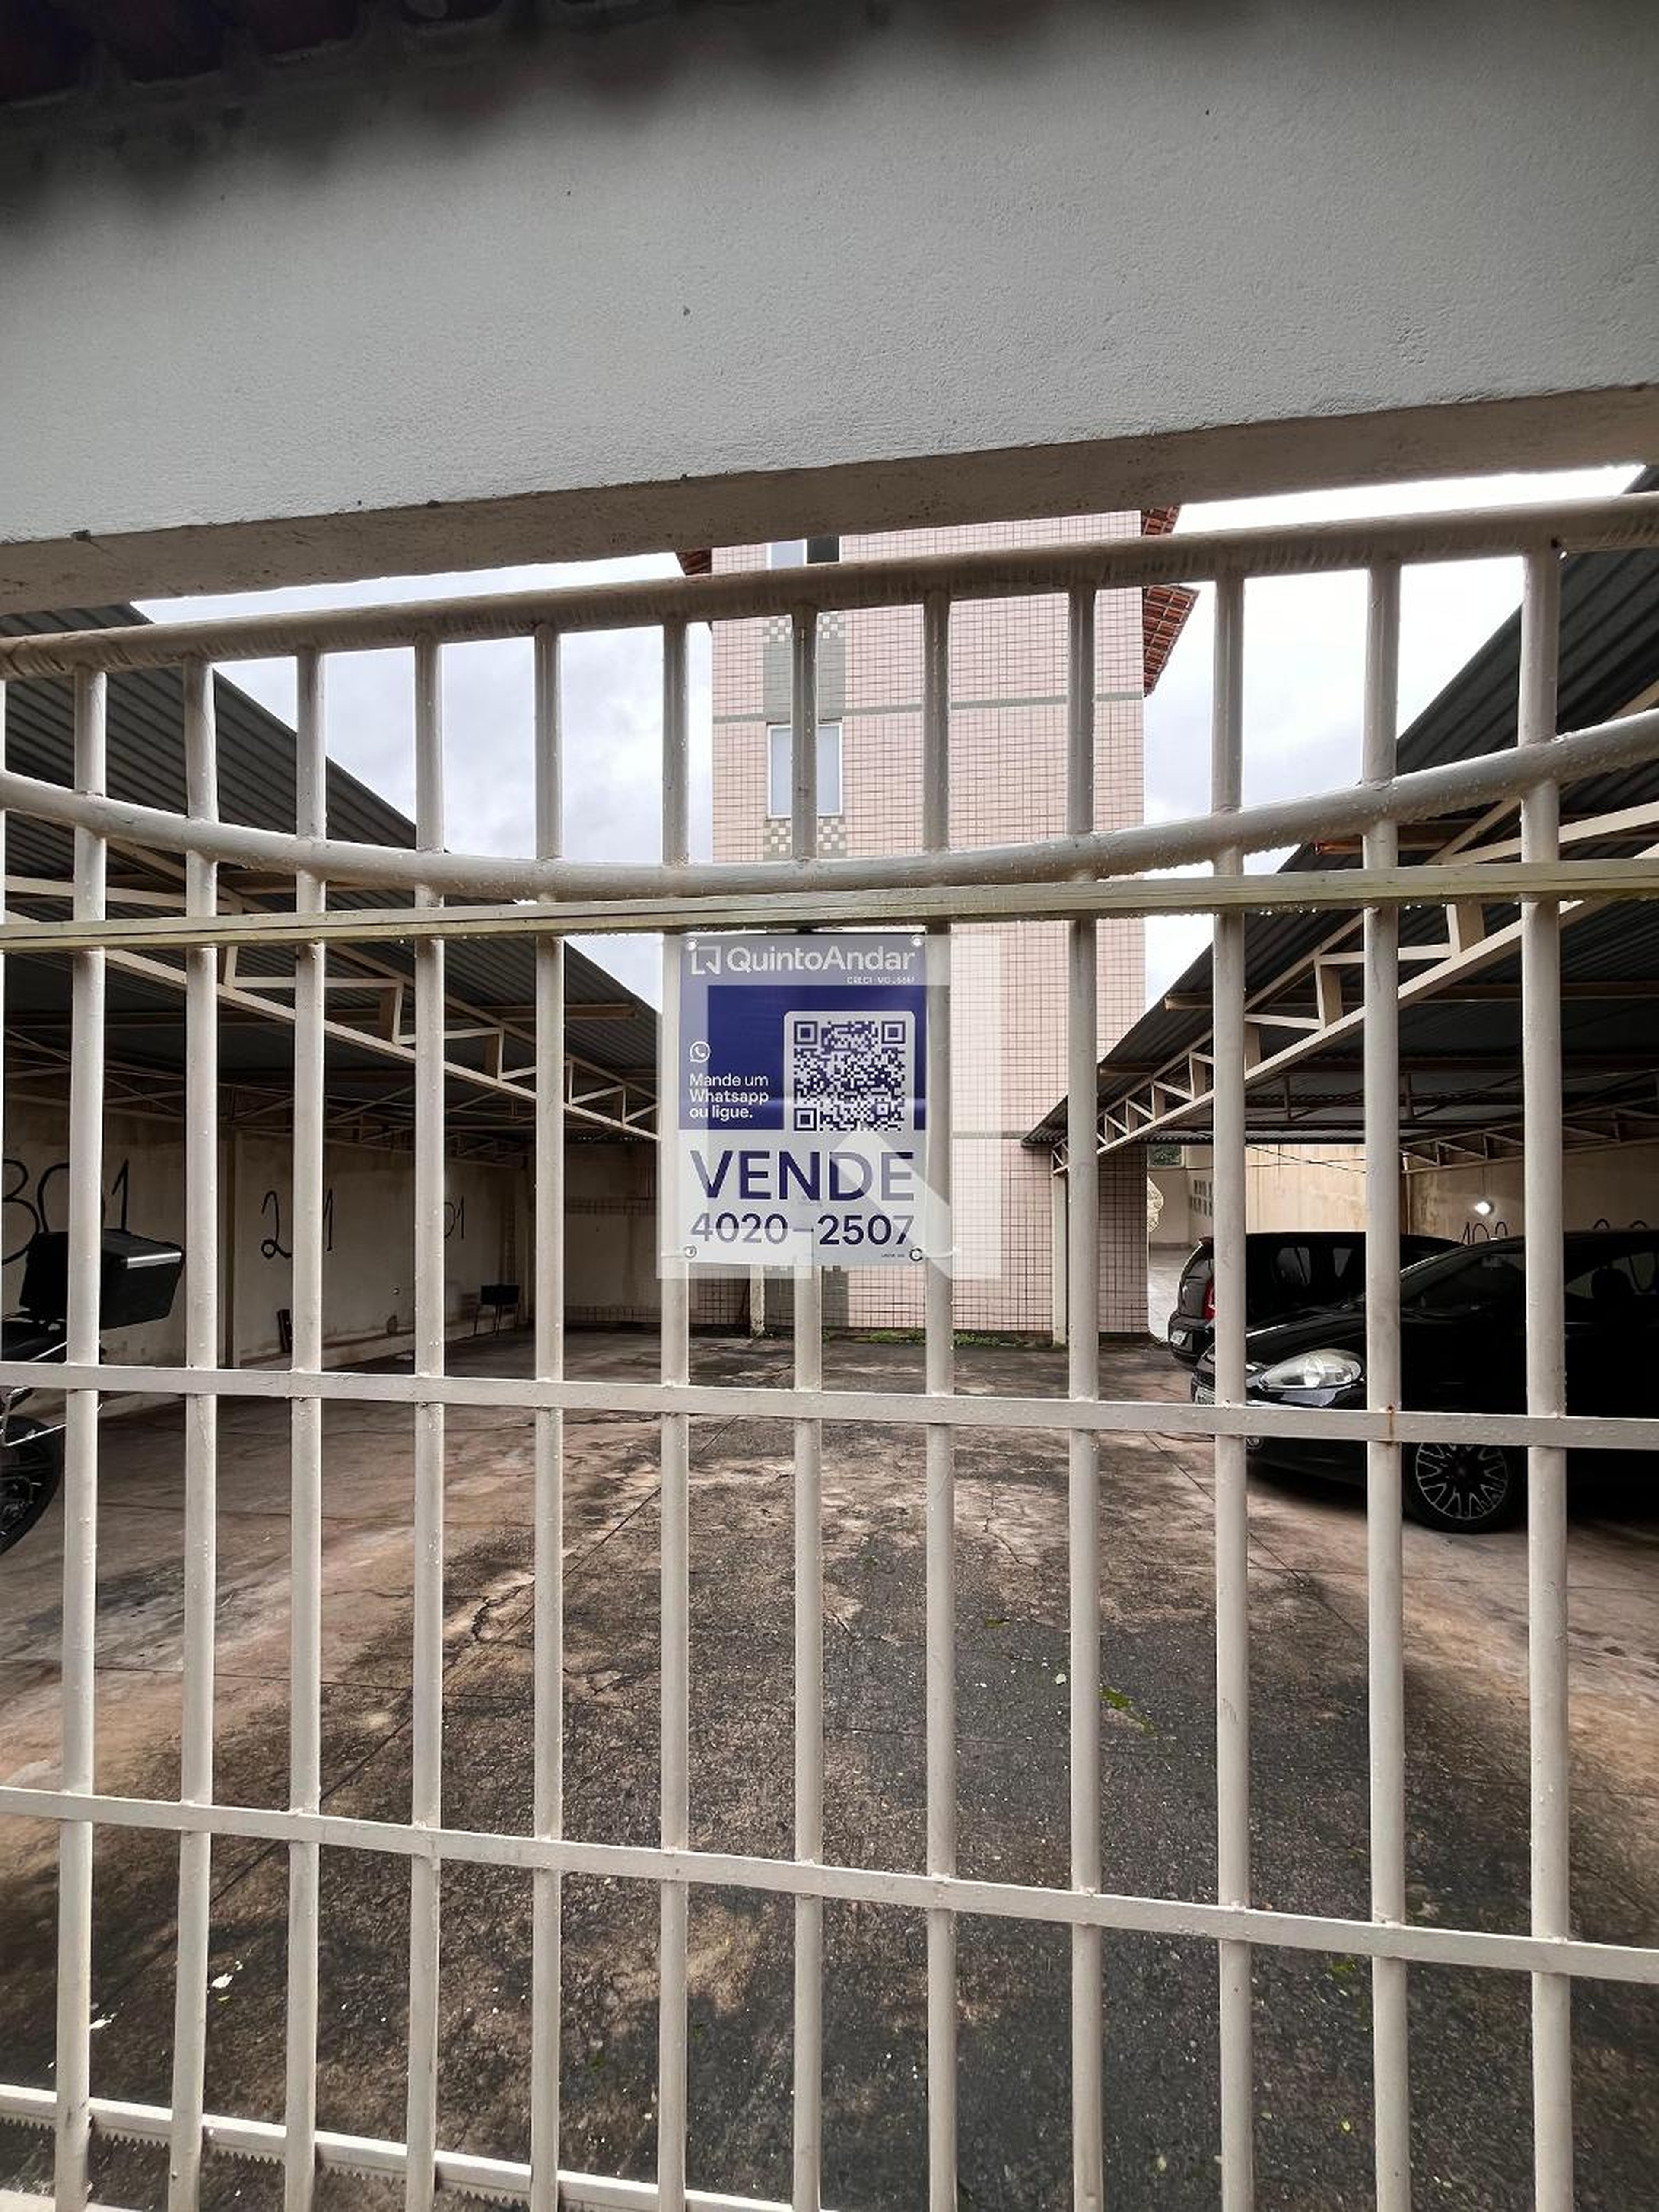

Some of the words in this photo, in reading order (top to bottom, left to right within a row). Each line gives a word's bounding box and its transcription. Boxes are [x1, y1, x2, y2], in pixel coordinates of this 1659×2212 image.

[726, 945, 915, 973] QuintoAndar
[690, 1073, 741, 1086] Mande
[744, 1075, 769, 1086] um
[689, 1088, 769, 1105] Whatsapp
[689, 1108, 709, 1118] ou
[712, 1104, 753, 1122] ligue.
[690, 1150, 915, 1201] VENDE
